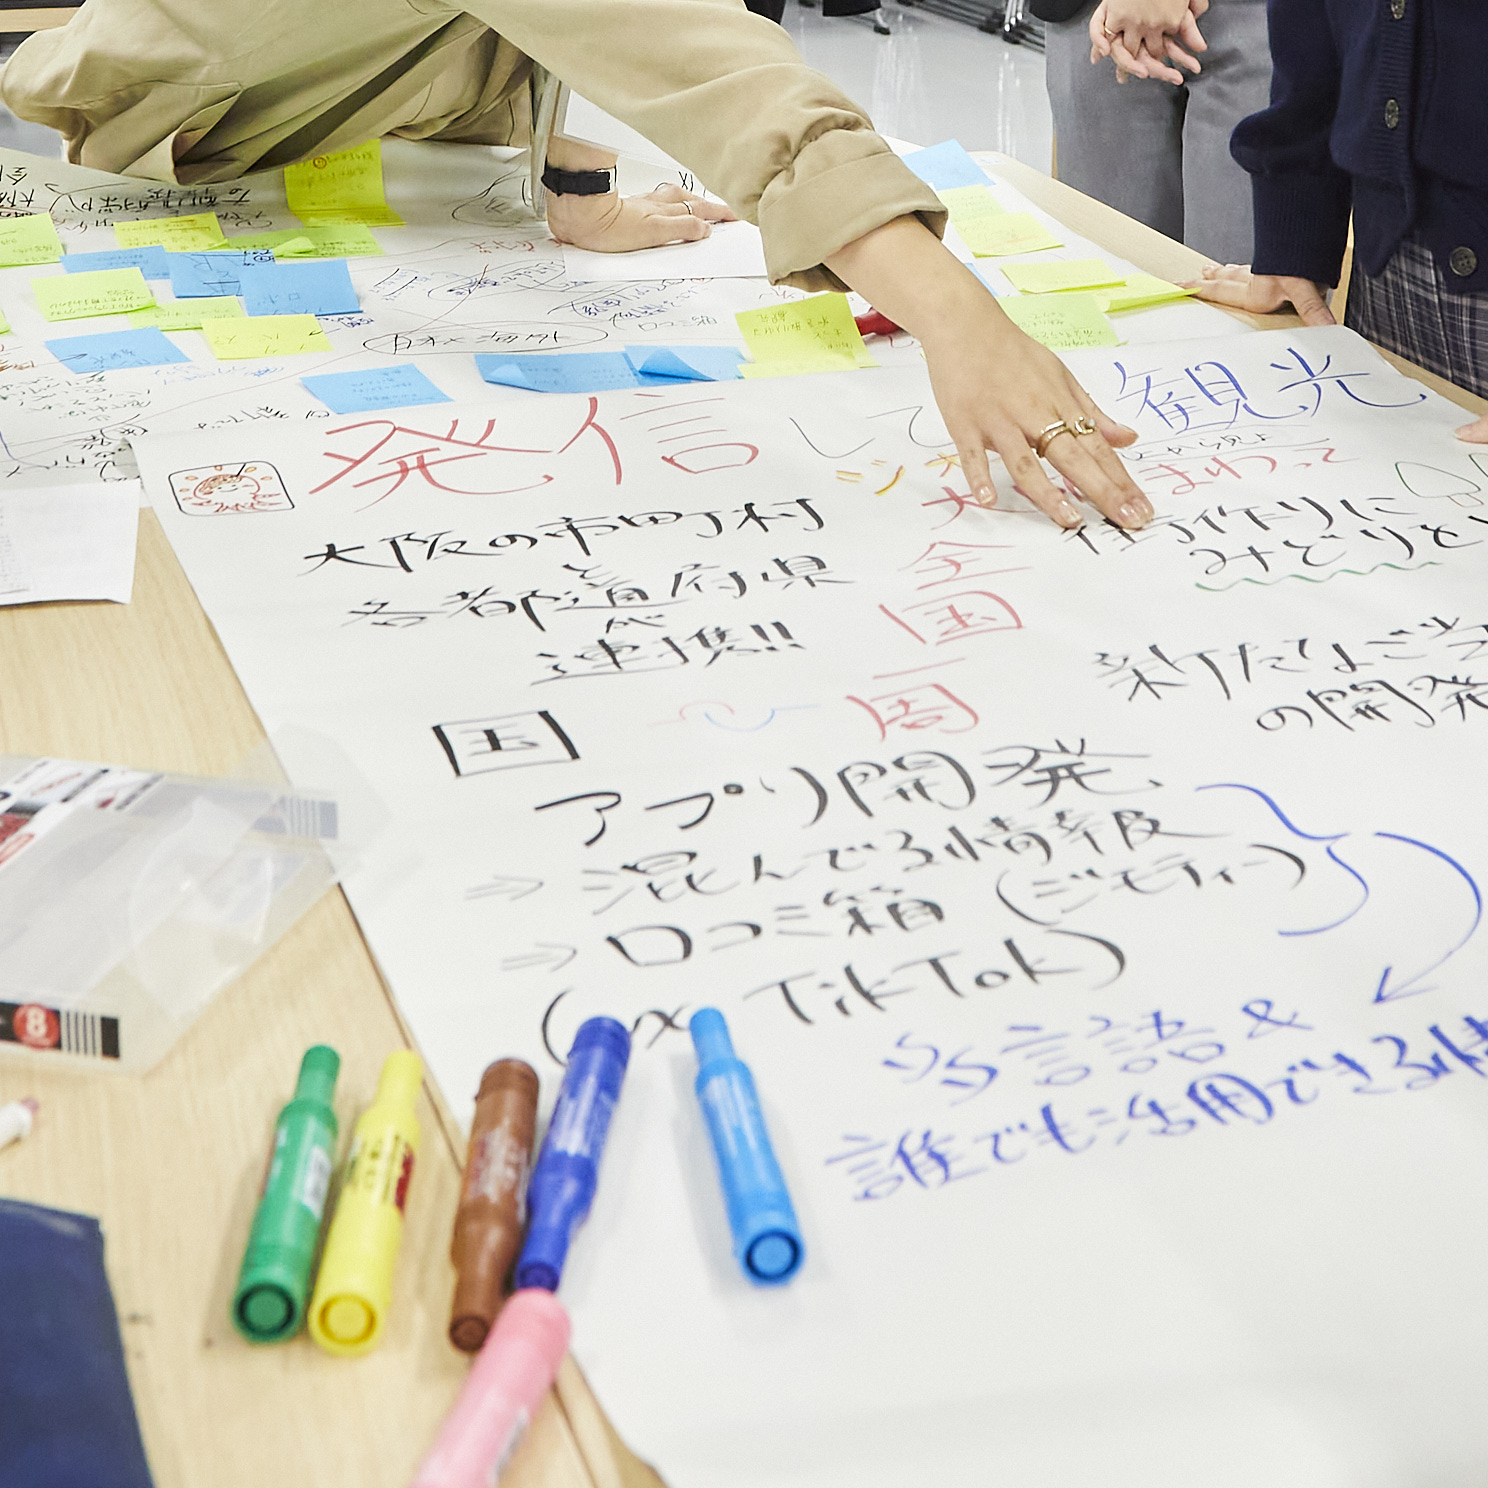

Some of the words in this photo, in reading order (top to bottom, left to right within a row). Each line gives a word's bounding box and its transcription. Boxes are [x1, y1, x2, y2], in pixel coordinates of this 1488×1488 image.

[1113, 346, 1428, 434] 観光
[302, 496, 828, 579] 大阪の市町村
[340, 553, 855, 634] 各都道府県
[431, 710, 581, 778] 国
[533, 737, 1166, 848] アプリ開発
[580, 806, 1236, 916] 混んでる情報
[24, 1006, 48, 1039] 8
